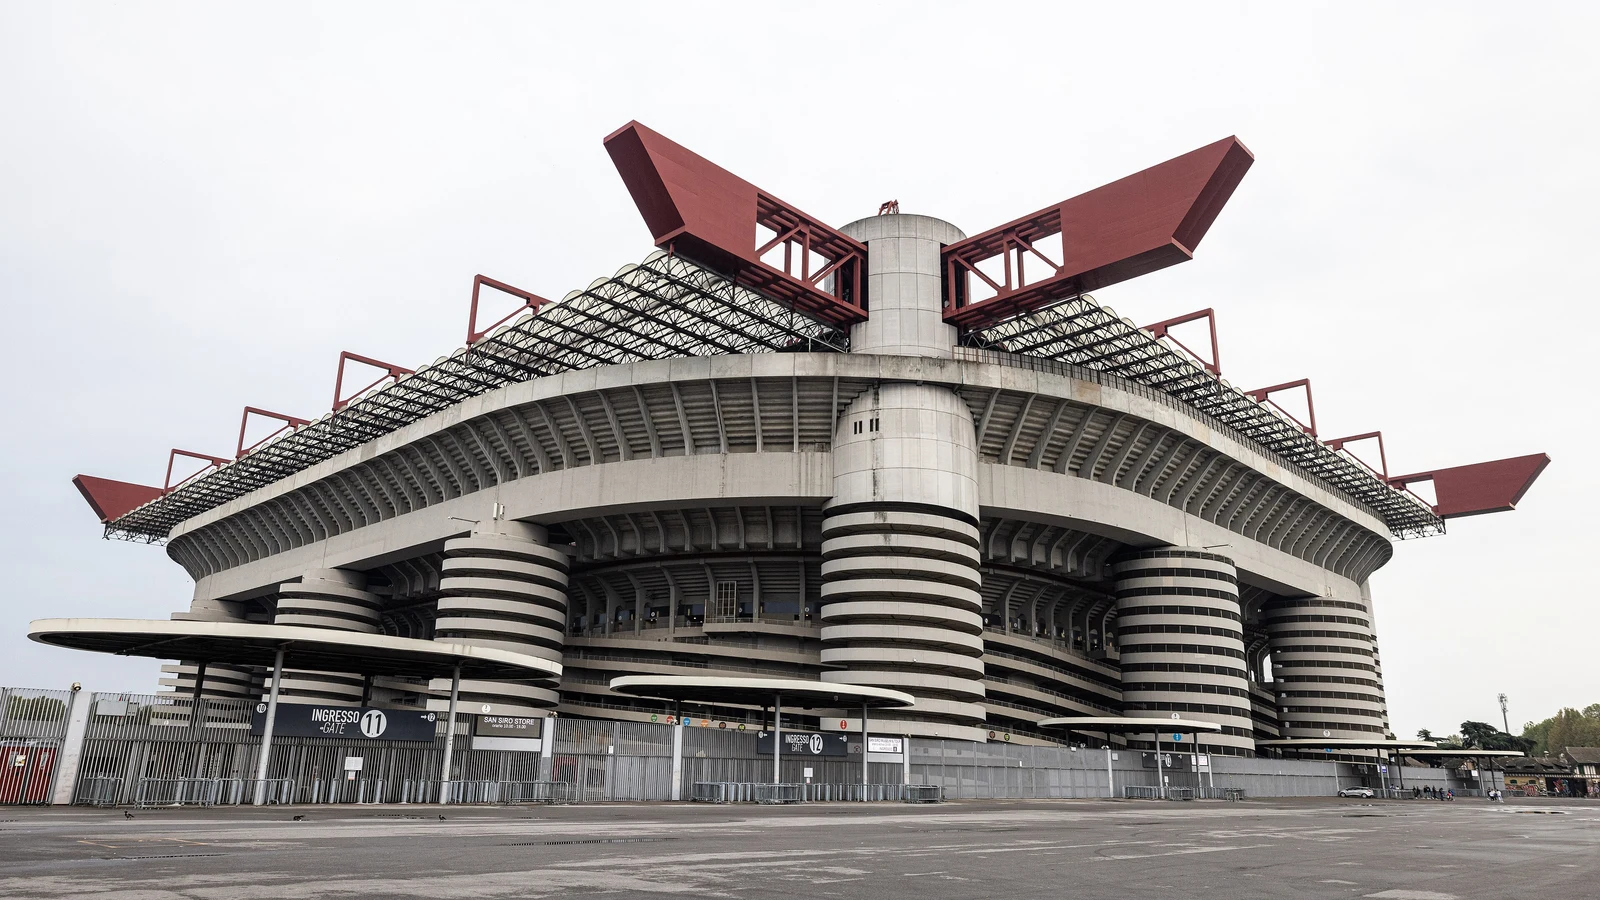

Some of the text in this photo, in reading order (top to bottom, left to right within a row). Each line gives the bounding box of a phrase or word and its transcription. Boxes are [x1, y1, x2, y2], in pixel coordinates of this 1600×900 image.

[312, 708, 382, 735] INGRESSO 11
[323, 722, 346, 734] GATE
[785, 734, 821, 751] INGRESSO 12
[791, 744, 803, 752] GATE
